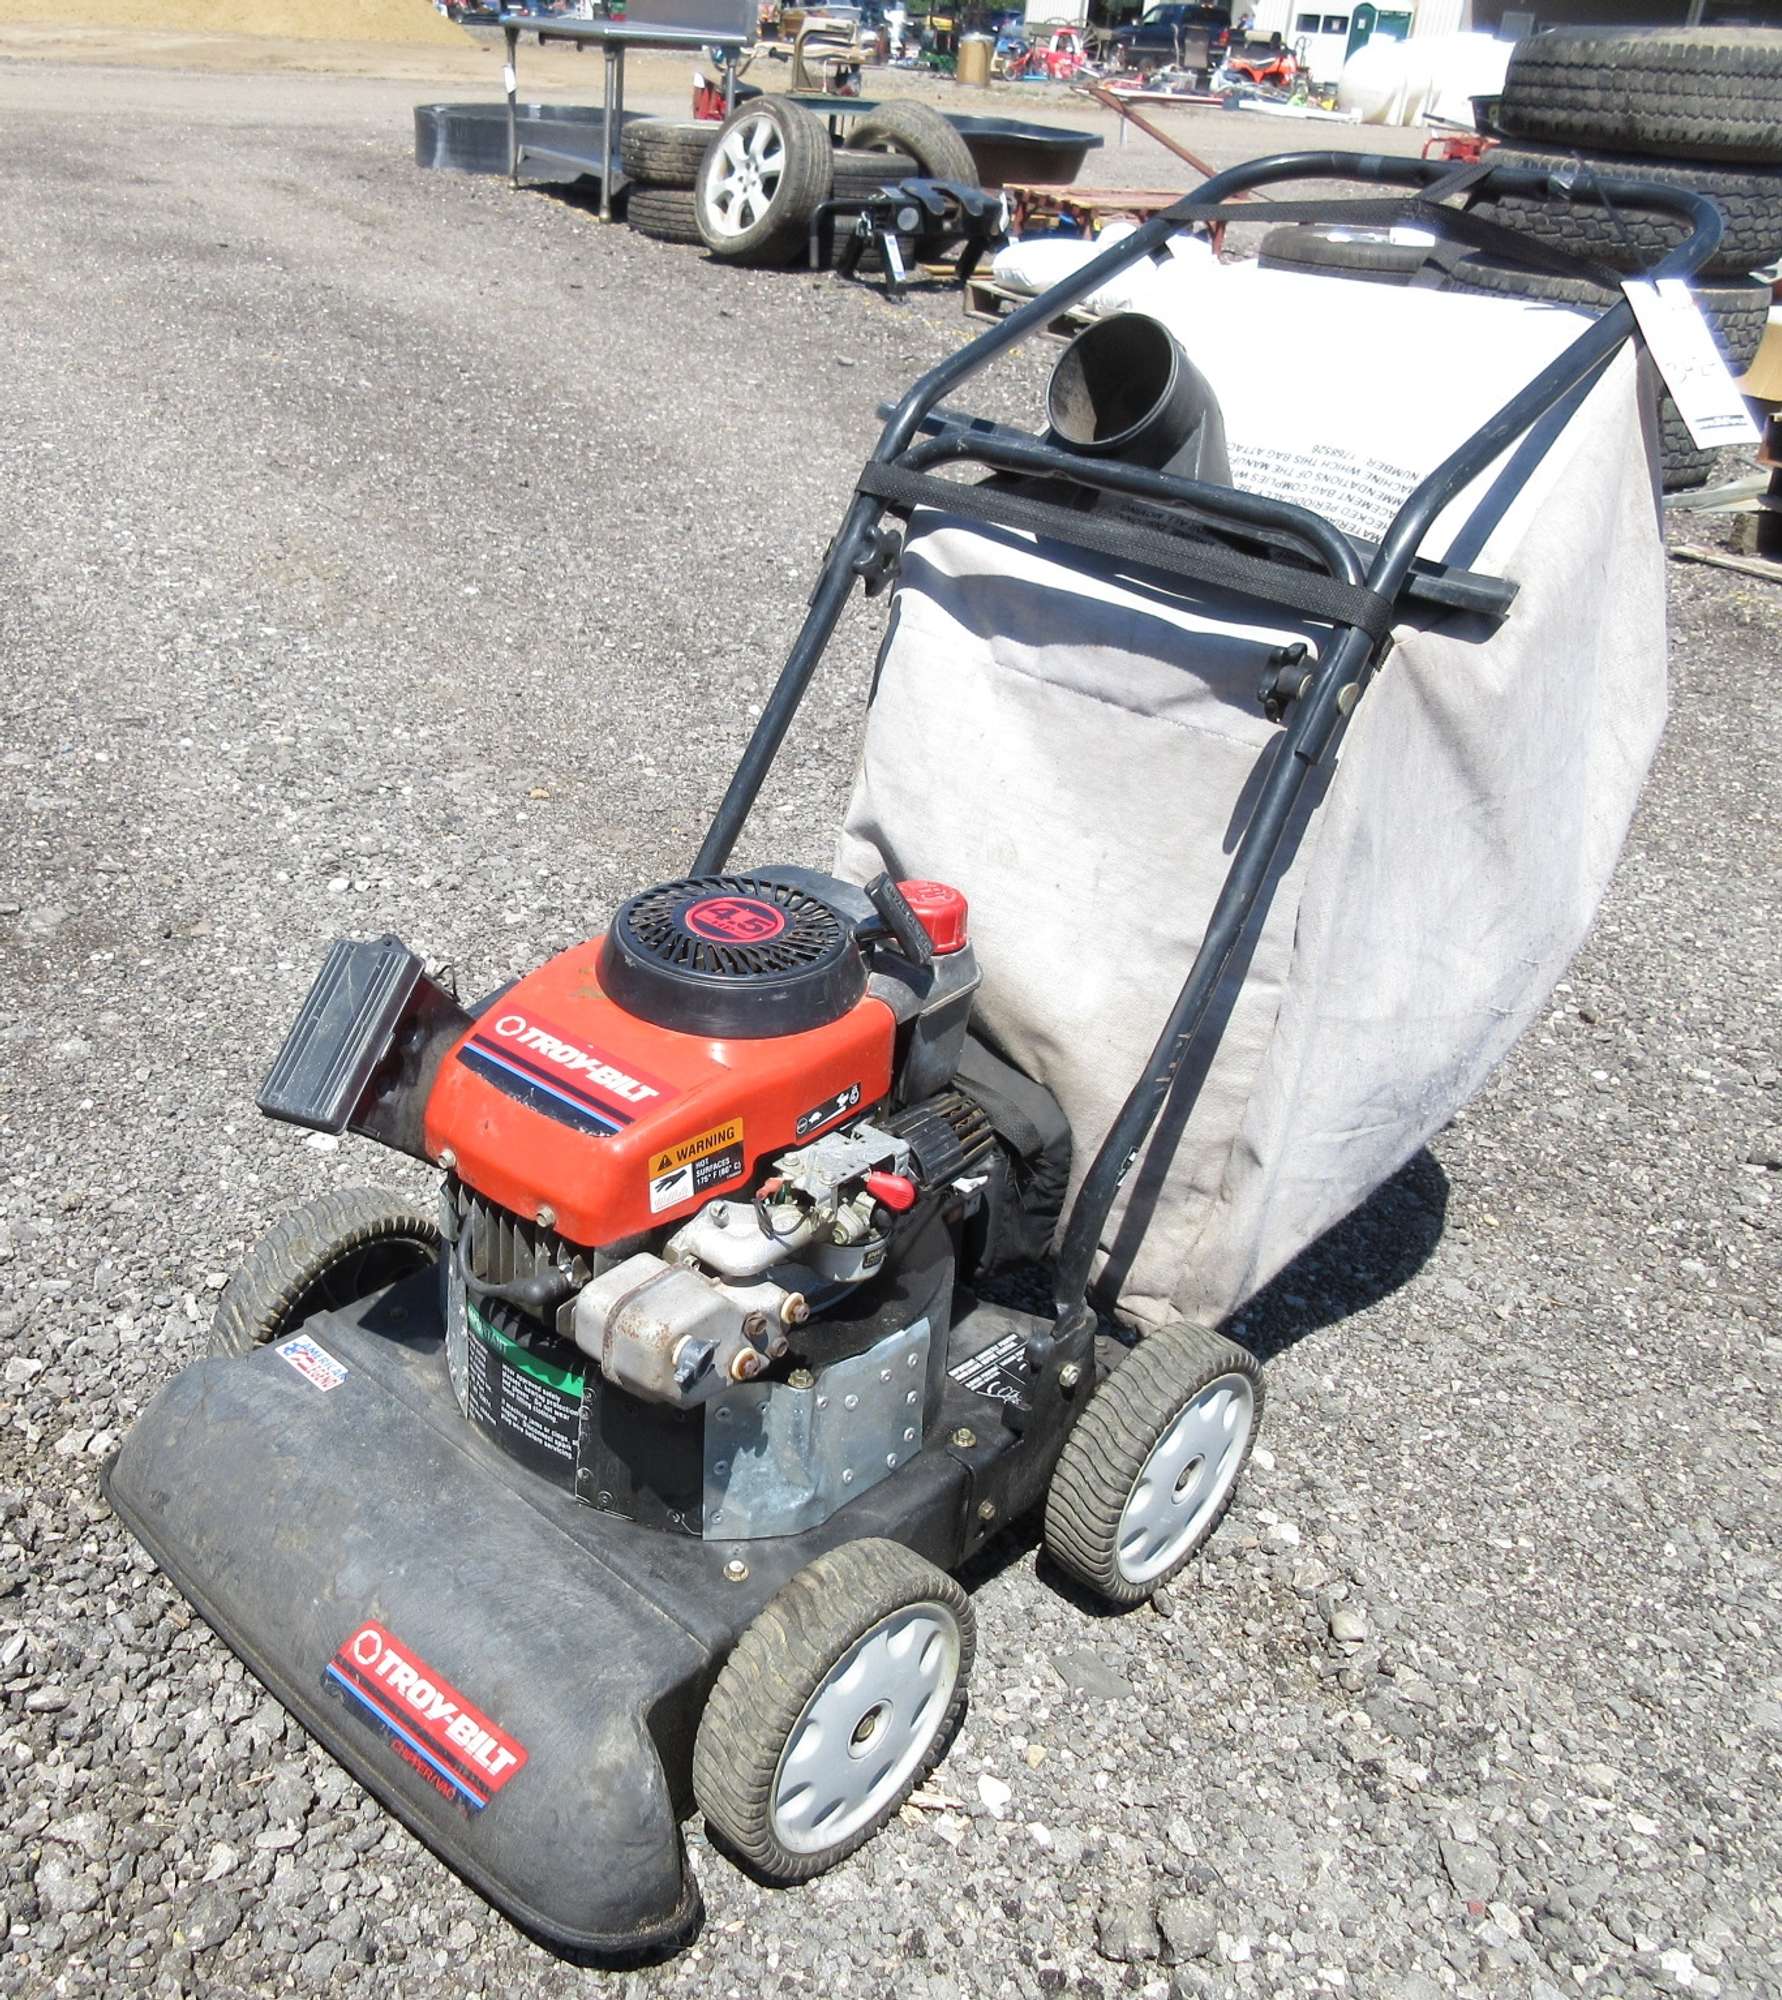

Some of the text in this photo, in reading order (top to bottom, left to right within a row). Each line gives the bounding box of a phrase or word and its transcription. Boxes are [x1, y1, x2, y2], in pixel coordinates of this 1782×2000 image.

[1224, 441, 1264, 455] ATTAC
[1265, 449, 1292, 461] BAG
[1293, 455, 1318, 467] THIS
[1321, 459, 1360, 475] WHICH
[1229, 457, 1405, 506] MMENDATIONS OF THE MANUF
[1250, 473, 1308, 492] COMPLIES
[1311, 485, 1337, 498] BAG
[1338, 493, 1396, 519] ACEMENT
[1340, 507, 1388, 530] HECKED
[707, 907, 772, 933] 4.5
[515, 1026, 660, 1103] TROY-BILT
[676, 1126, 735, 1162] WARNING
[695, 1157, 709, 1169] HOT
[695, 1157, 731, 1178] SURFACES
[713, 1169, 718, 1179] F
[543, 1388, 560, 1403] safety
[546, 1398, 579, 1416] protection
[554, 1410, 570, 1421] wear
[554, 1439, 572, 1452] spark
[374, 1648, 518, 1776] TROY-BILT
